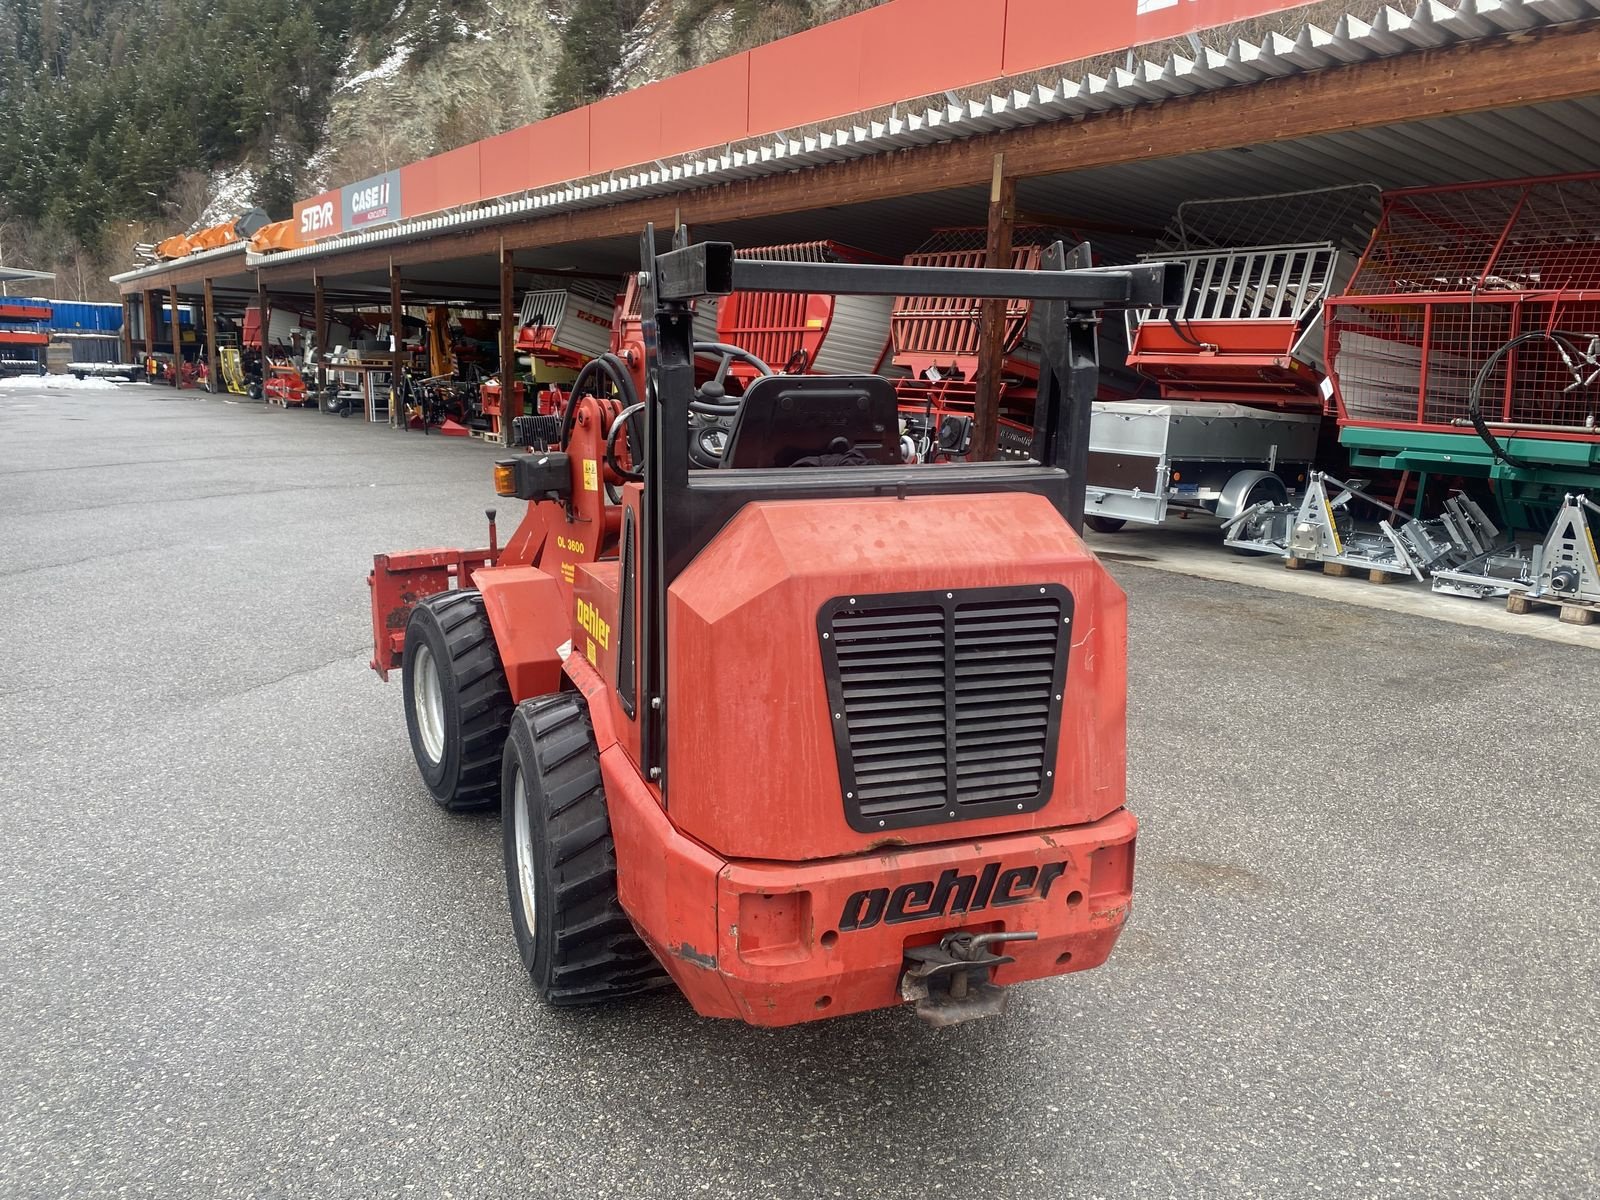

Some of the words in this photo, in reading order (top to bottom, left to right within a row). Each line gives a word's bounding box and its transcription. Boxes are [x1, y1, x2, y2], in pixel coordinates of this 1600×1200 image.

[351, 185, 379, 213] CASE
[301, 201, 333, 233] STEYR
[557, 535, 566, 549] OL
[567, 539, 585, 554] 3600
[577, 597, 611, 652] oehler
[838, 860, 1068, 932] oehler
